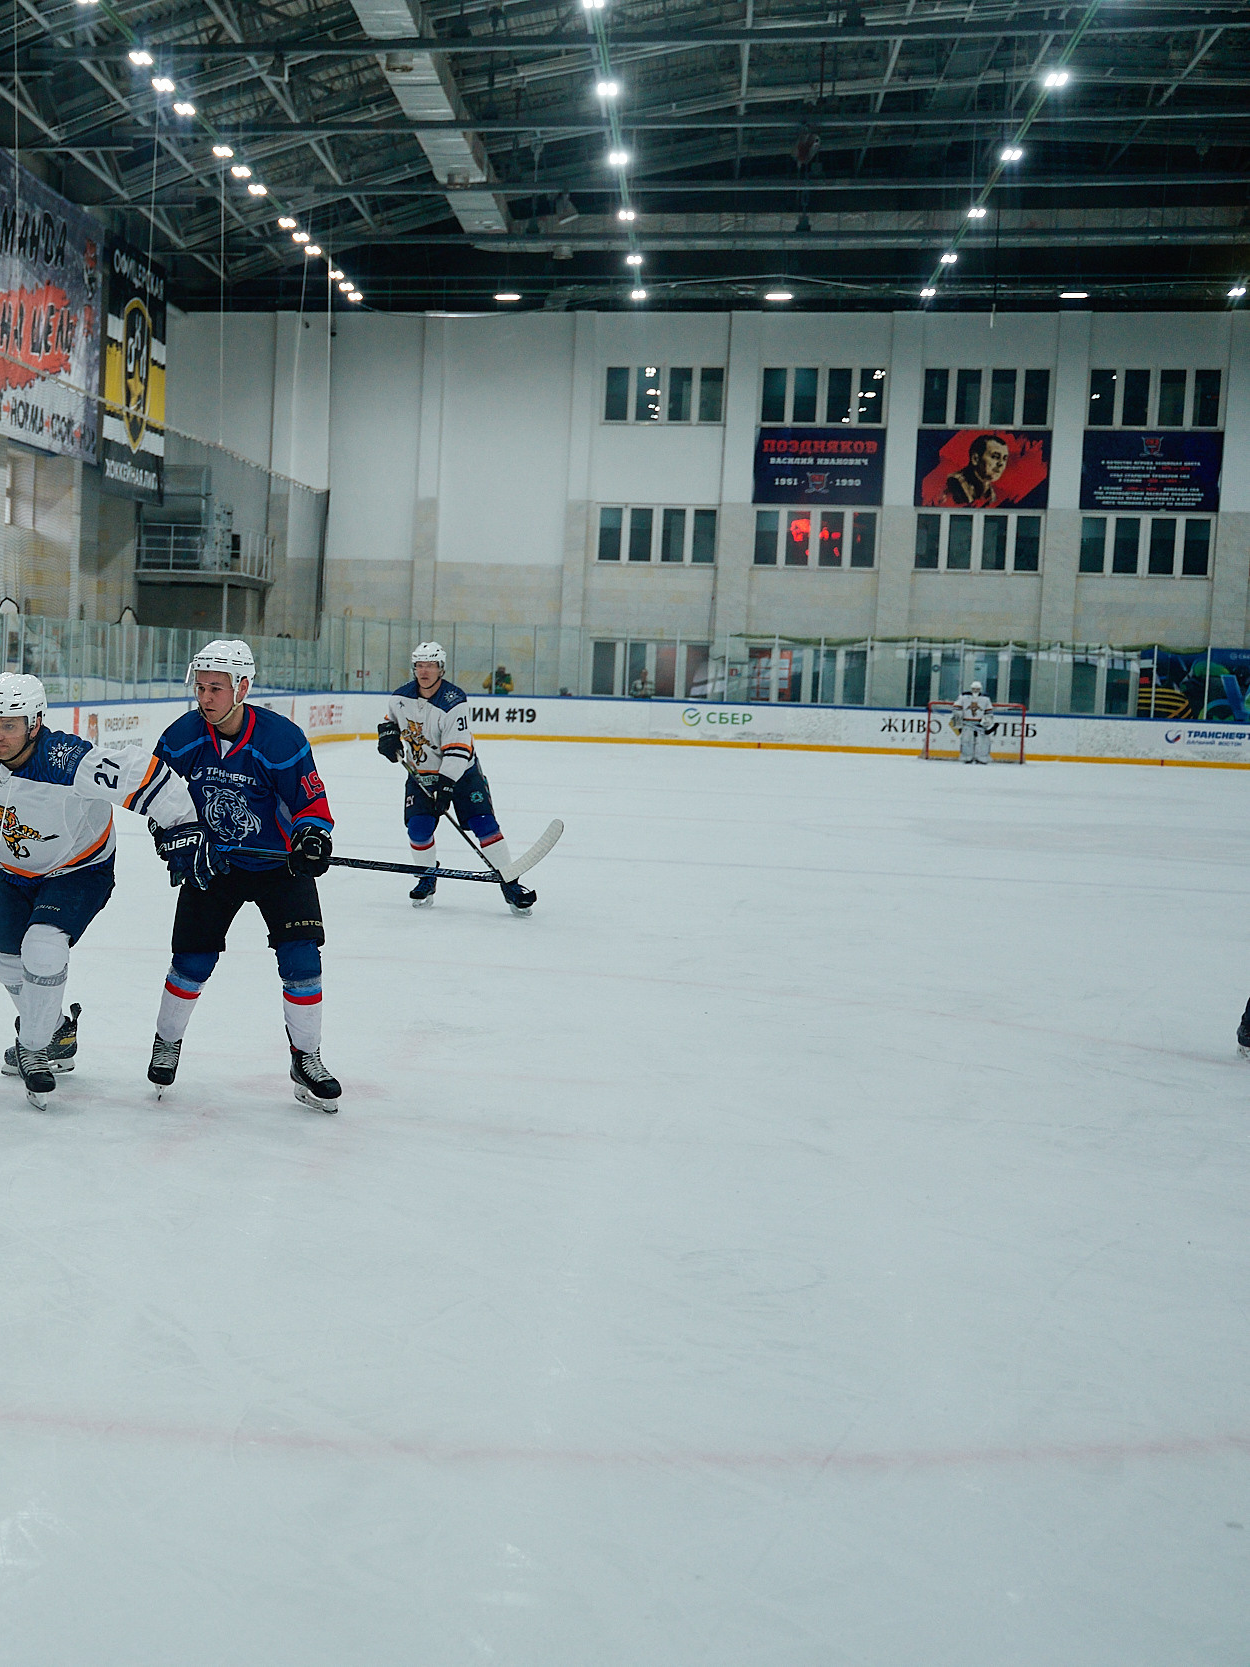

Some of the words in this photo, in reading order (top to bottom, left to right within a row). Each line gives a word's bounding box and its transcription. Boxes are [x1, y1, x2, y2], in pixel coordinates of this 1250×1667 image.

[762, 439, 879, 454] ПОЗДНЯКОВ
[456, 715, 468, 732] 31
[468, 707, 500, 723] ИМ
[505, 708, 537, 724] #19
[706, 711, 753, 726] СБЕР
[991, 722, 1038, 738] ЛЕБ
[159, 835, 198, 854] AUER
